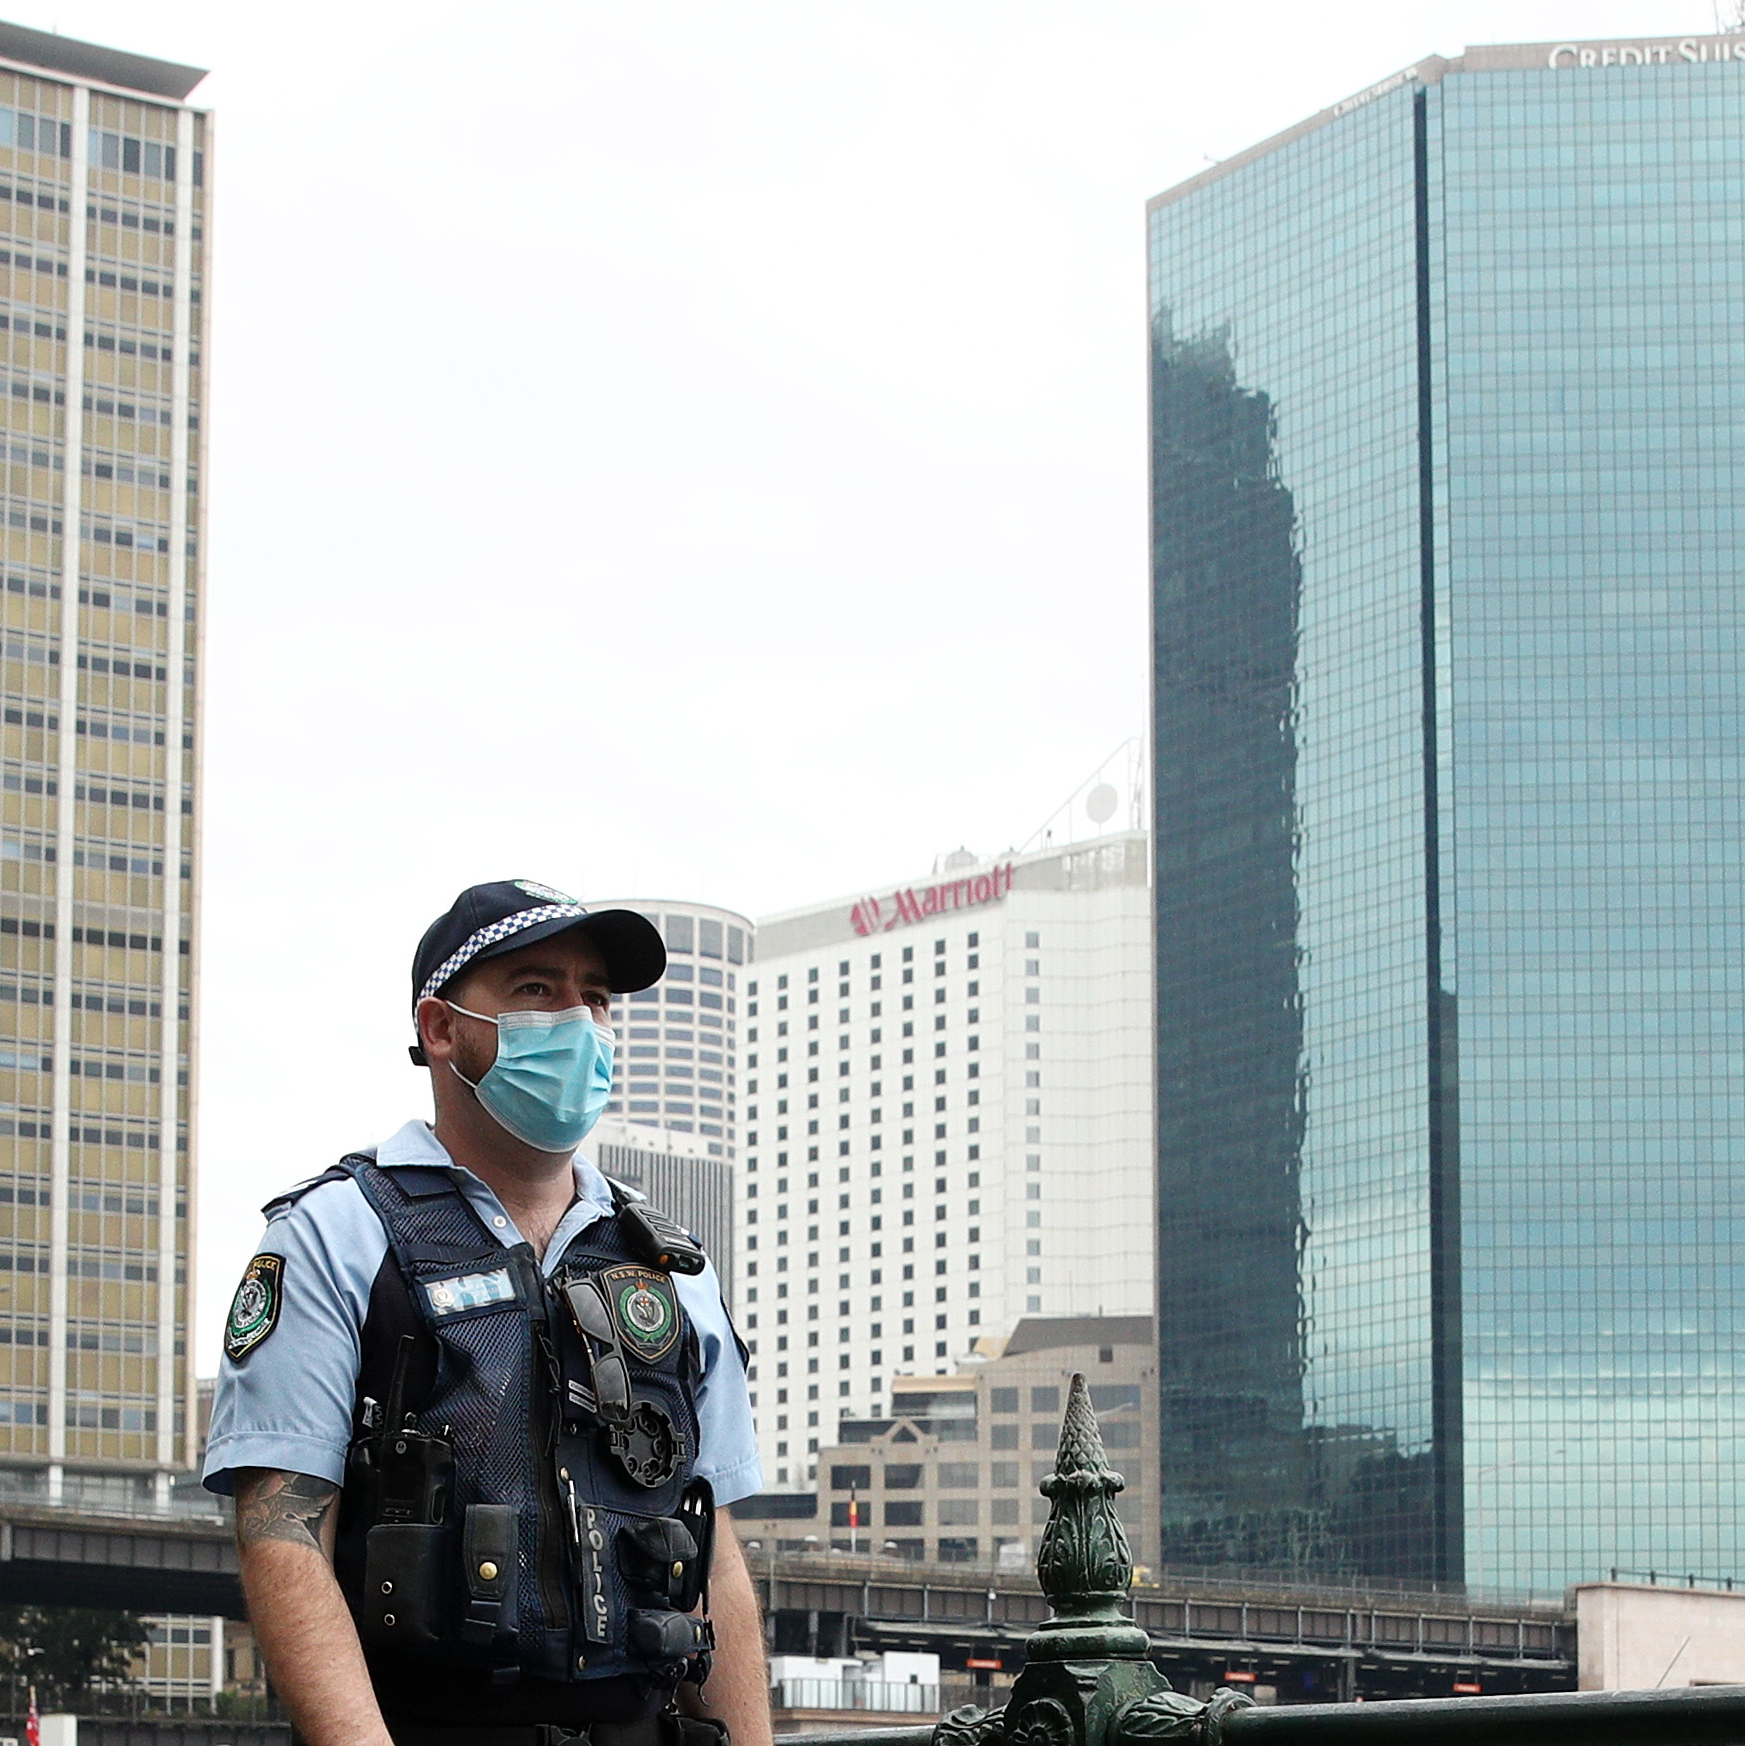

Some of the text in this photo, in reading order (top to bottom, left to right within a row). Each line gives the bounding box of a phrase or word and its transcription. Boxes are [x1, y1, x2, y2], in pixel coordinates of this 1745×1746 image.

[884, 861, 1014, 931] Marriott
[637, 1270, 666, 1283] POLICE
[586, 1509, 608, 1638] POLICE
